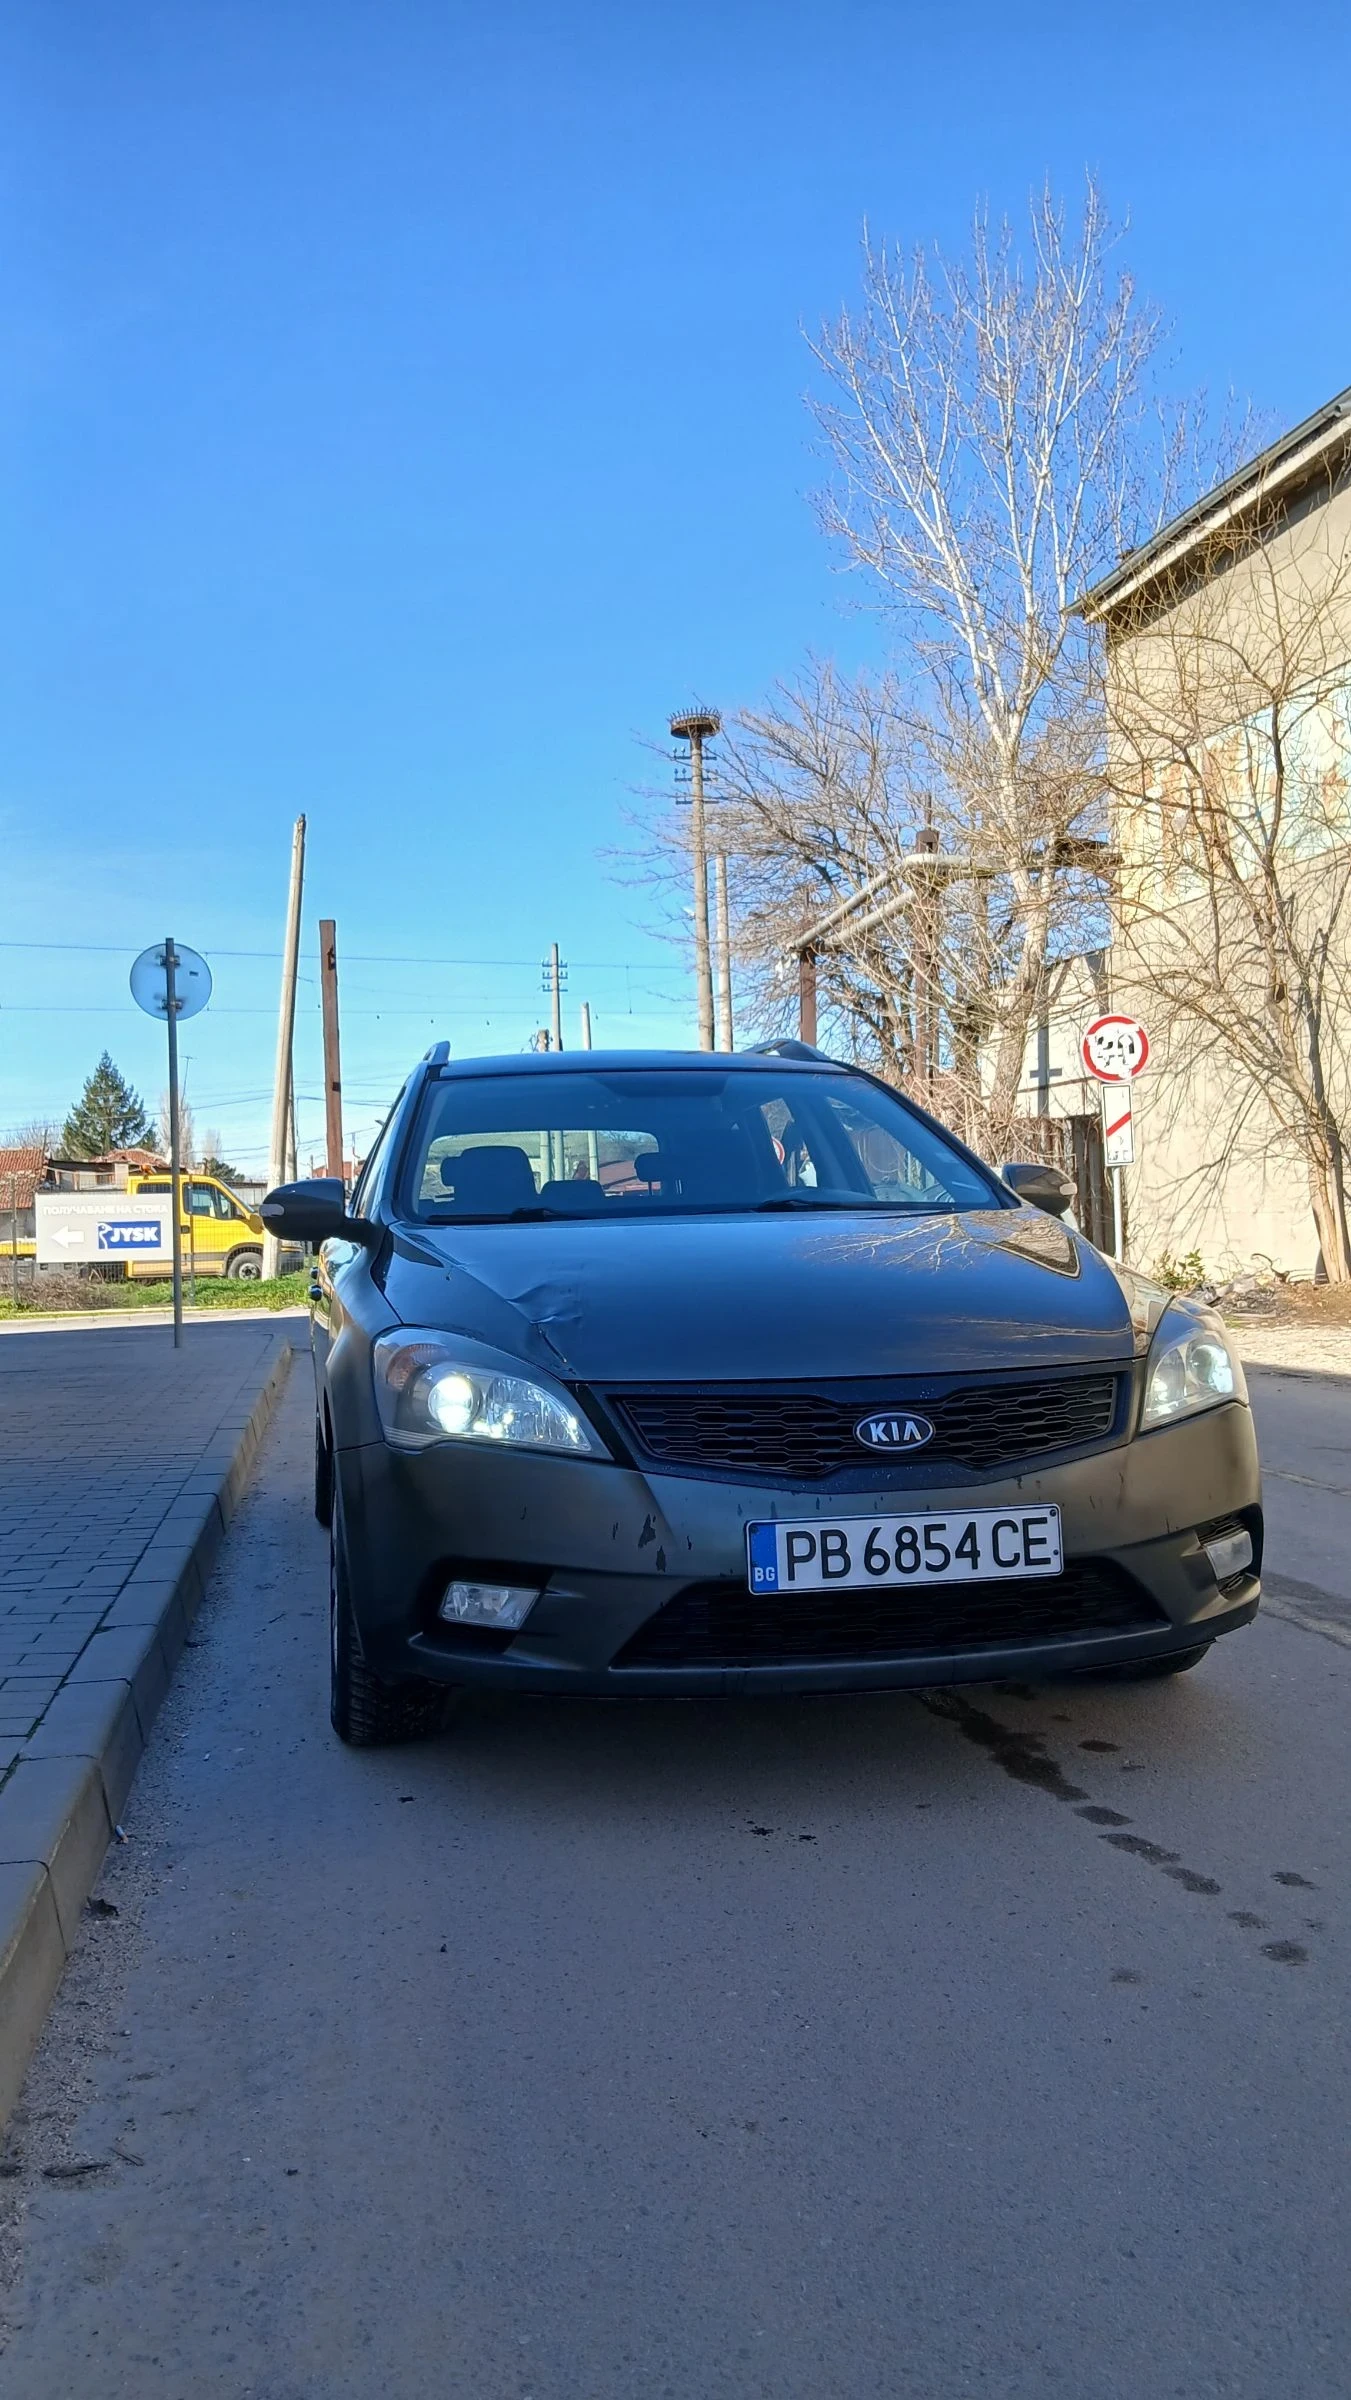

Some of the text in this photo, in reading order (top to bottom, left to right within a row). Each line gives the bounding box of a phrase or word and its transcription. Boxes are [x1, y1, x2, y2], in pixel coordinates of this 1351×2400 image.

[116, 1205, 132, 1214] НА
[110, 1226, 159, 1243] JYSK
[868, 1420, 922, 1443] KIA
[785, 1516, 1052, 1582] PB 6854 CE
[754, 1566, 776, 1583] BG
